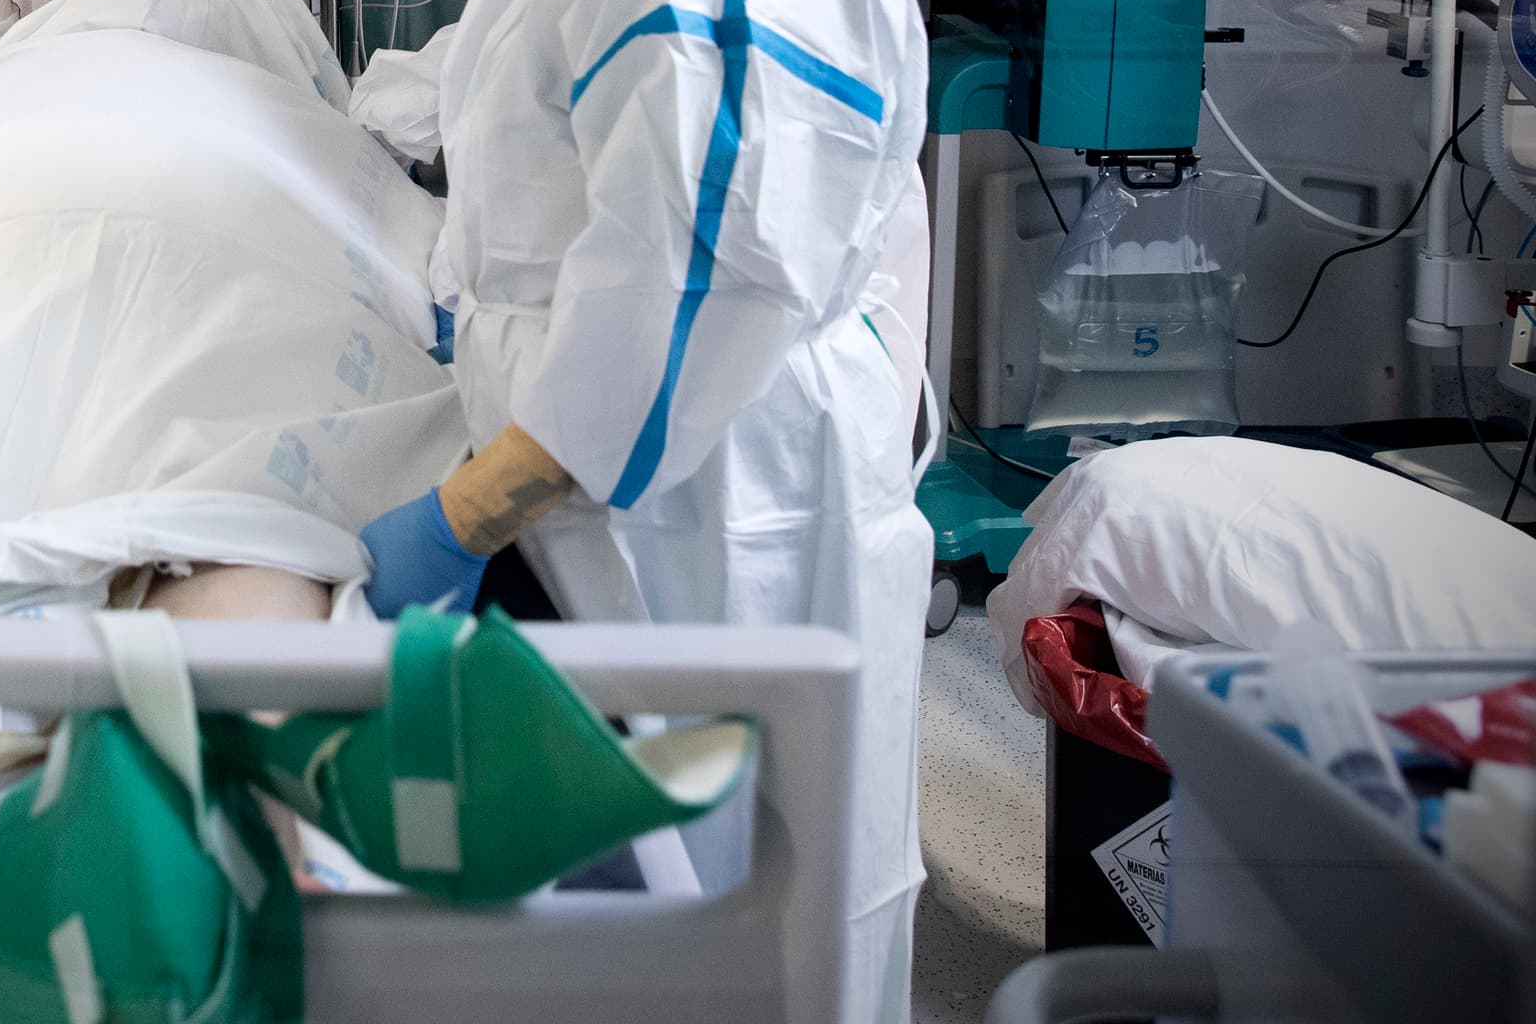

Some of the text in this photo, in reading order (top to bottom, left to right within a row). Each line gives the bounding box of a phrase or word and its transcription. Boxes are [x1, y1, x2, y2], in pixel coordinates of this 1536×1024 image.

[1133, 327, 1160, 358] 5
[1127, 859, 1166, 885] MATERIAS
[1107, 868, 1129, 894] UN
[1125, 895, 1156, 932] 3291
